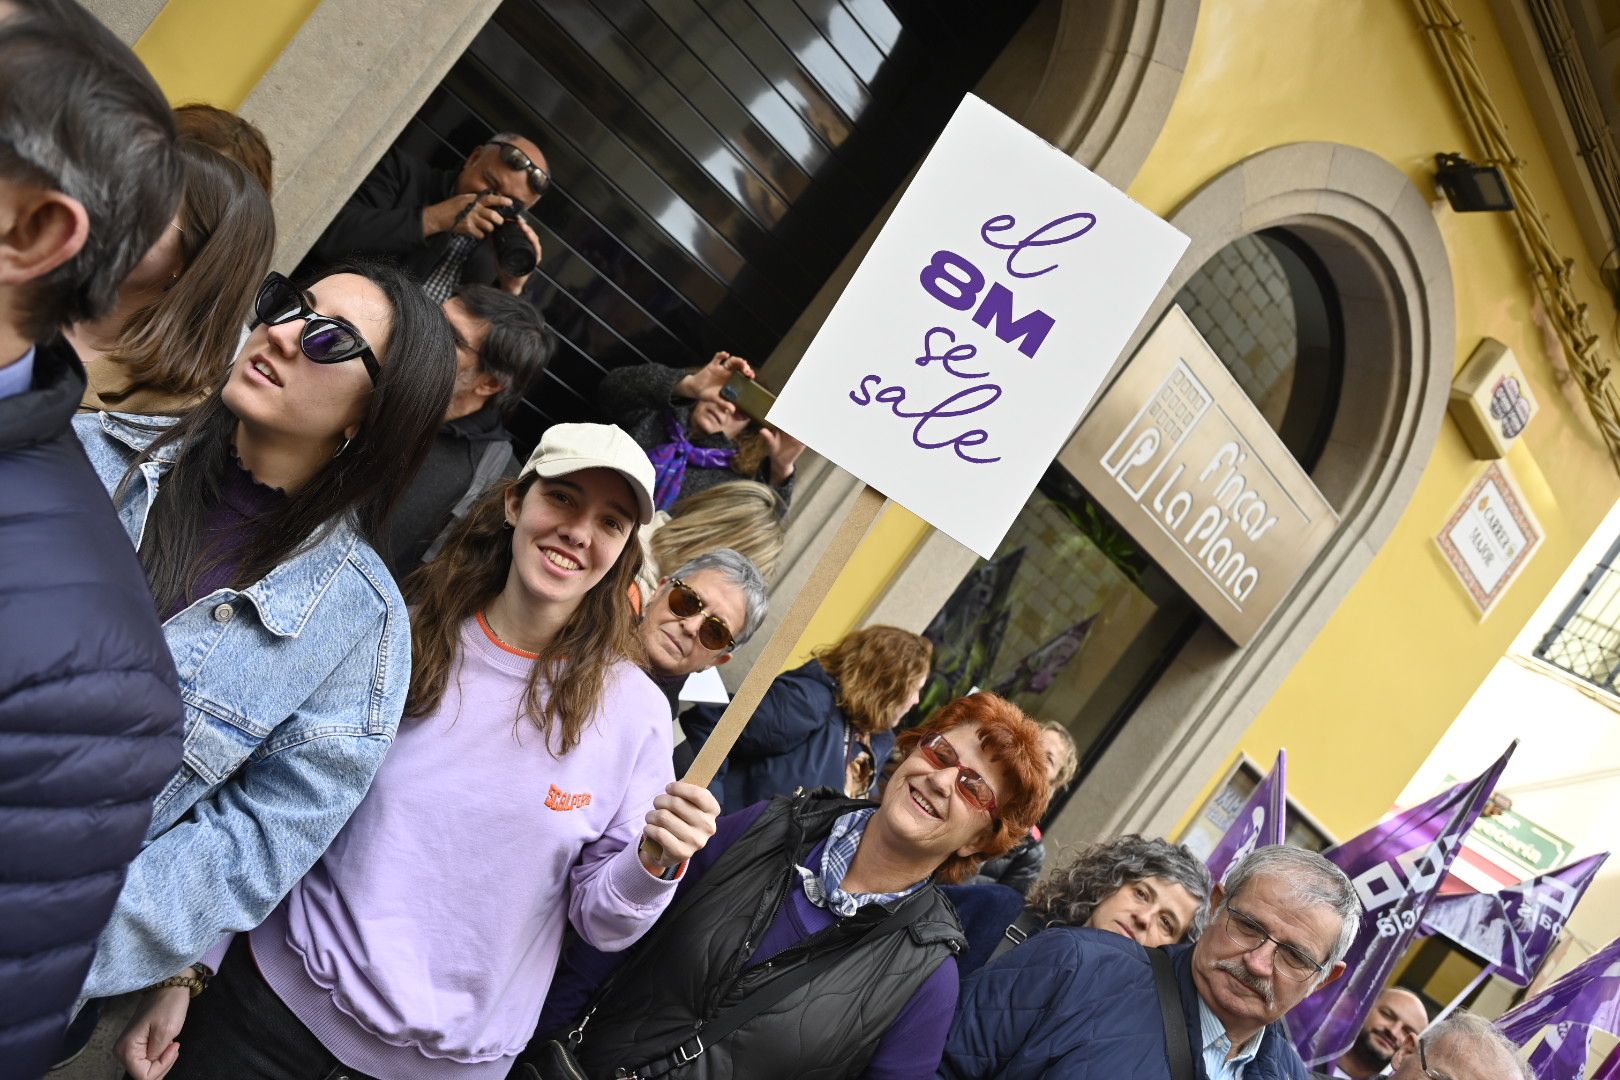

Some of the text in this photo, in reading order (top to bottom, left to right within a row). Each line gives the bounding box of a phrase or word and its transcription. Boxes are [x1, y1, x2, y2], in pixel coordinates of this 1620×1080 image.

[981, 213, 1097, 279] el
[919, 249, 1056, 359] 8M
[915, 326, 990, 379] se
[849, 374, 1002, 464] sale
[1153, 464, 1260, 602] La Plana
